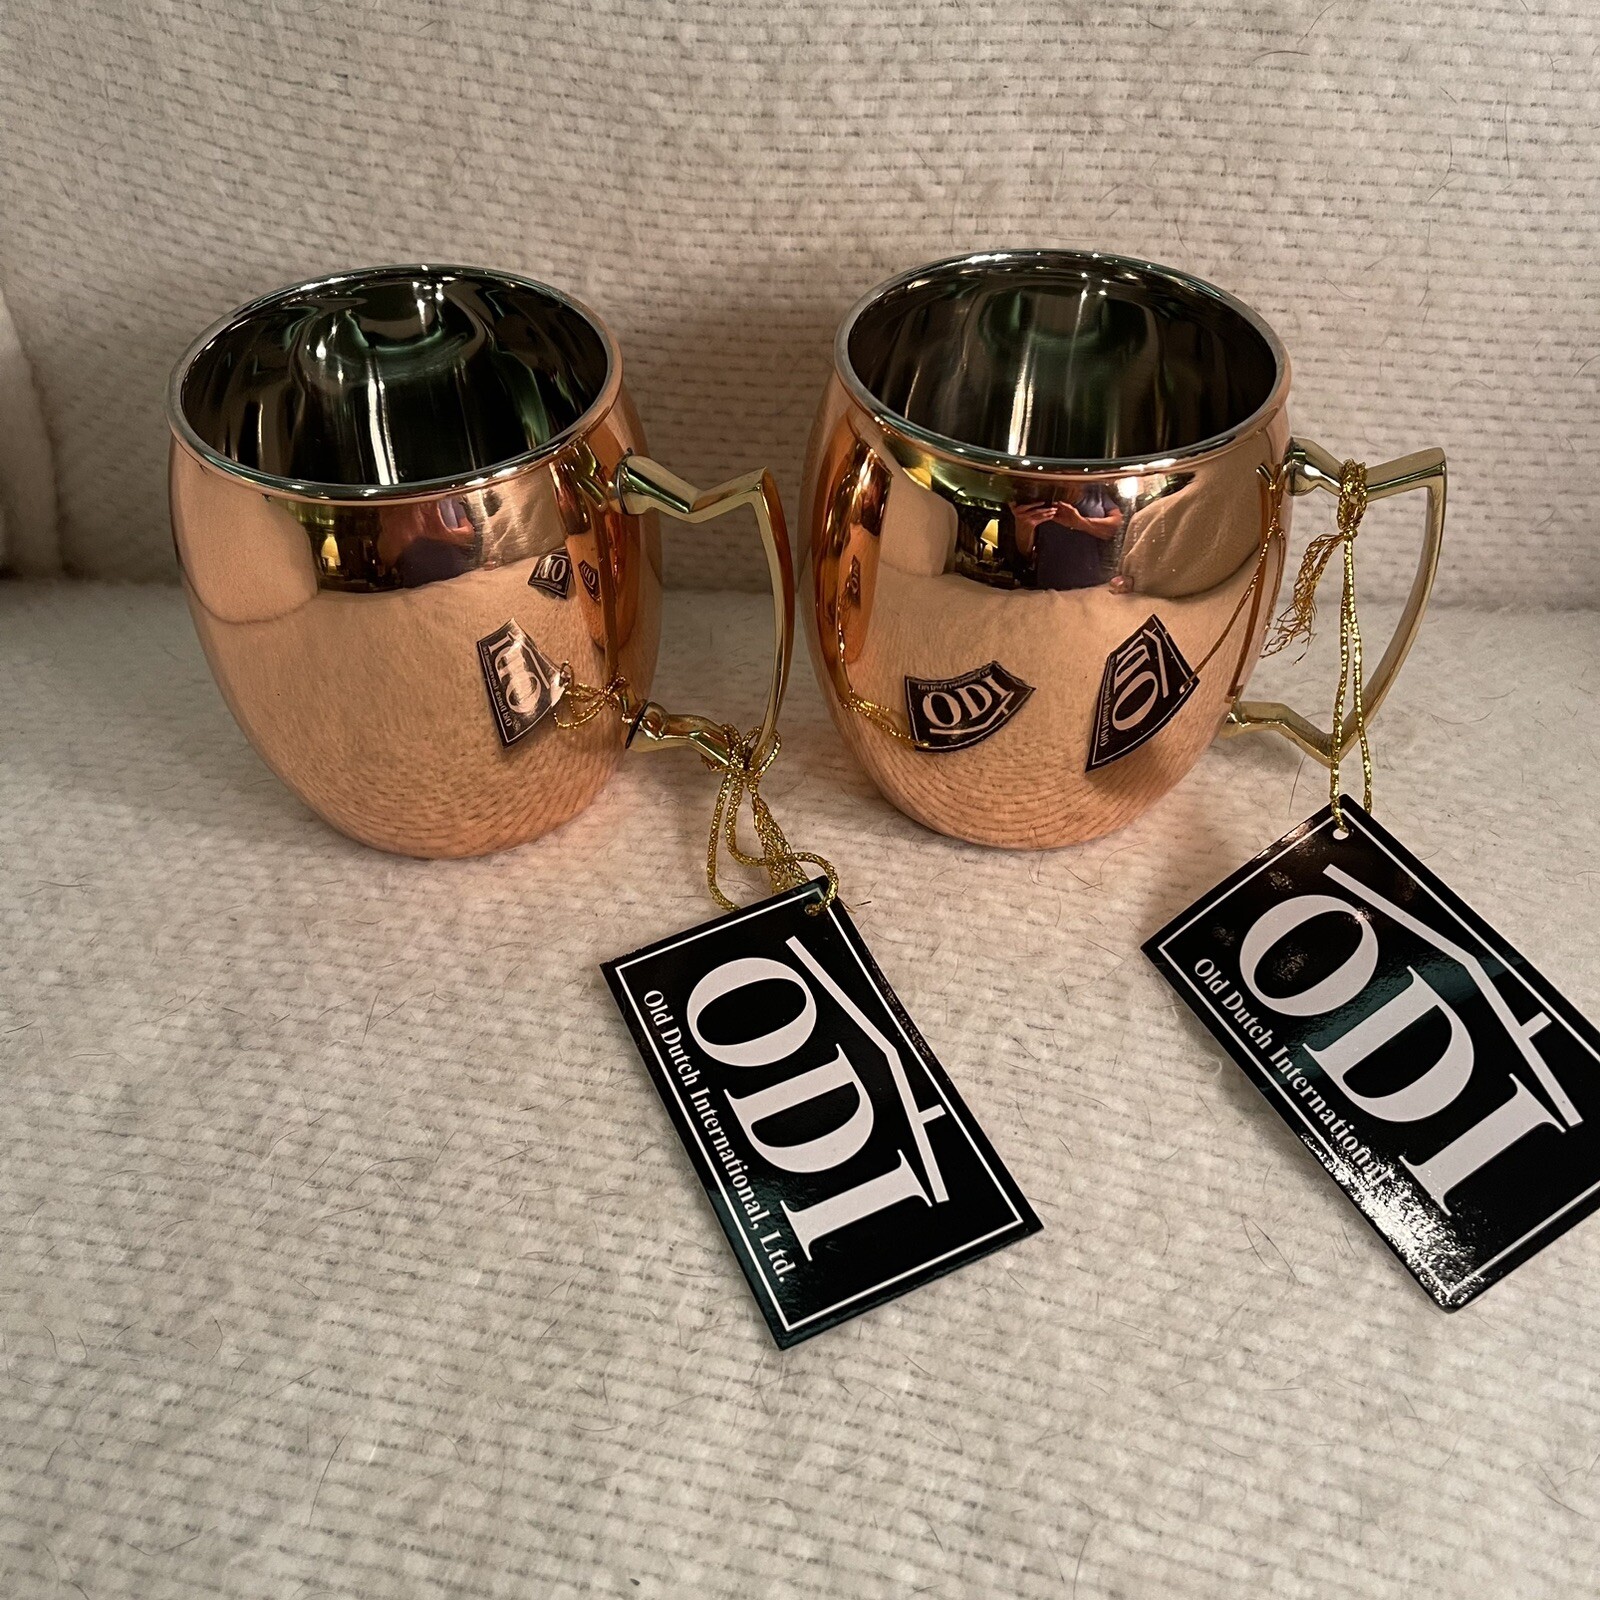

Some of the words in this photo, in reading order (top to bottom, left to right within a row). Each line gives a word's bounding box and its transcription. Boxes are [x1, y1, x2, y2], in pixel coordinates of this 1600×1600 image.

[644, 990, 674, 1026] Old
[661, 1027, 700, 1086] Dutch
[690, 1087, 770, 1230] International,
[760, 1230, 796, 1283] Ltd.
[686, 957, 932, 1261] ODI
[1194, 957, 1228, 994] Old
[1222, 991, 1273, 1049] Dutch
[1239, 894, 1566, 1216] ODI
